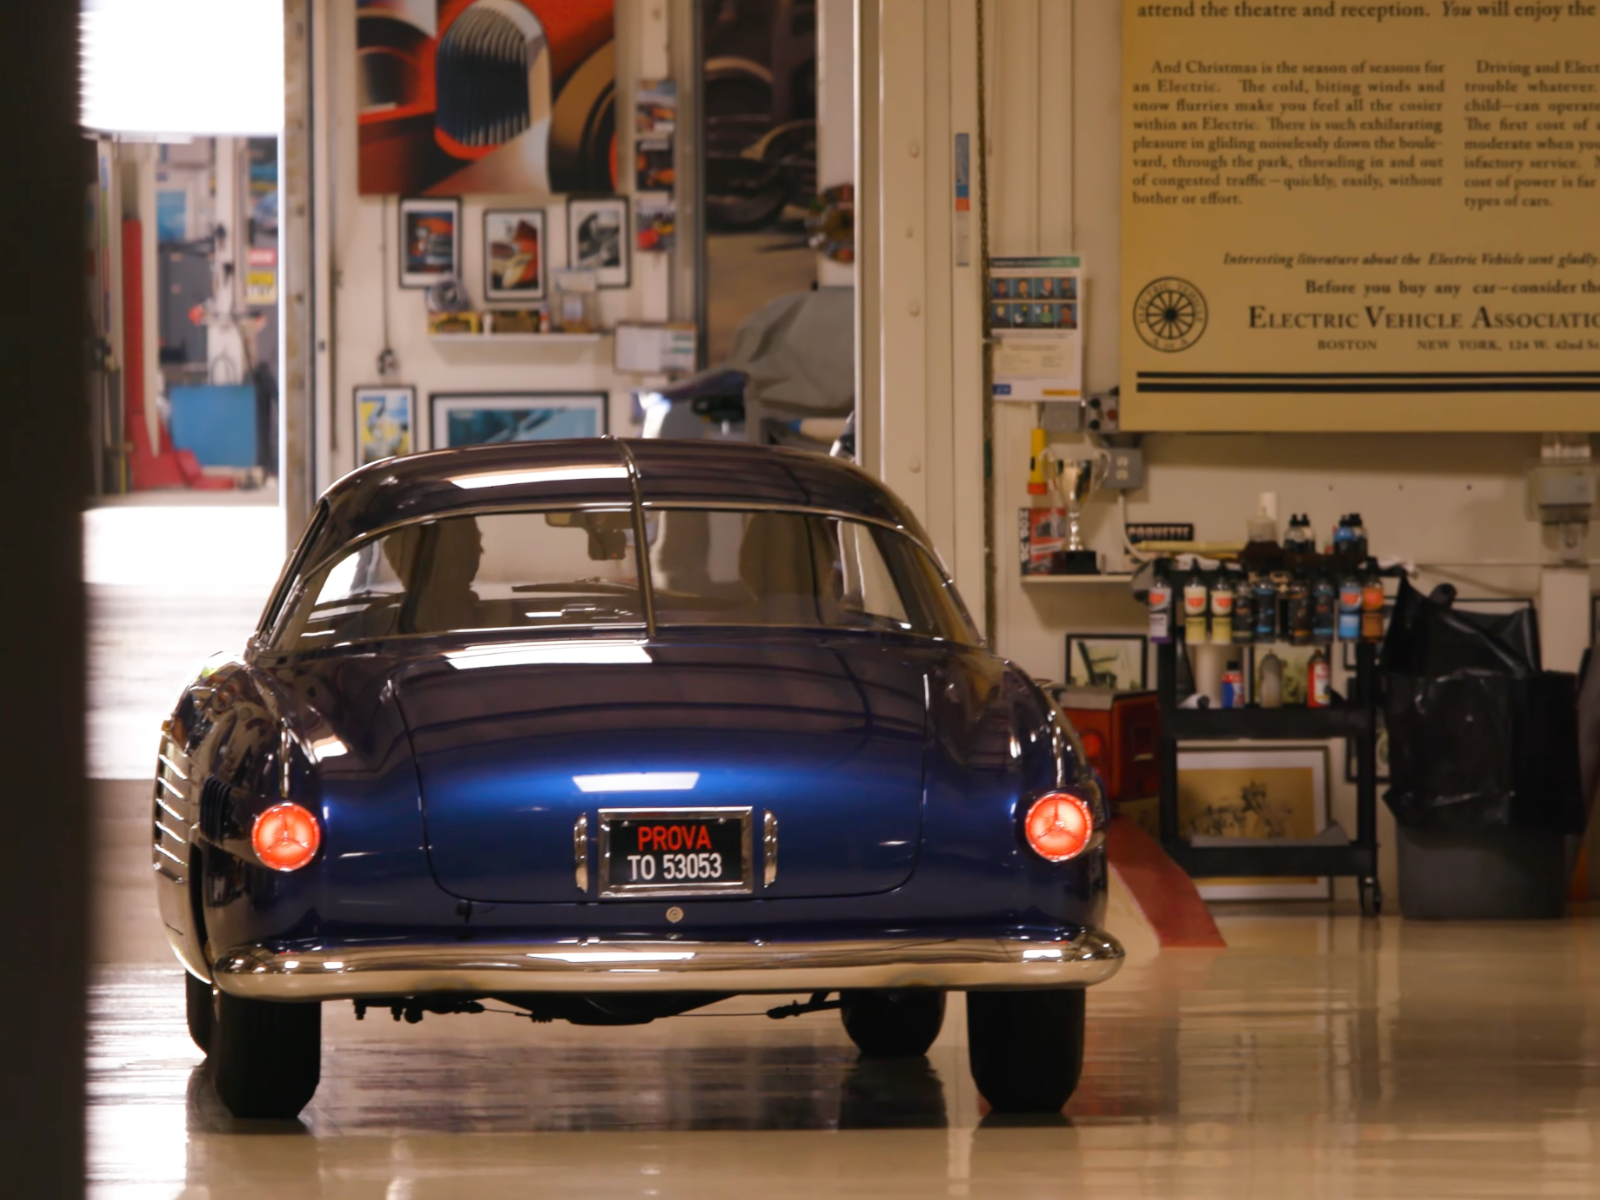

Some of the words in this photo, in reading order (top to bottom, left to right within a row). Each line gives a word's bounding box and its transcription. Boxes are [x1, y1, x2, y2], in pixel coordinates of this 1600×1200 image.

[1136, 0, 1196, 17] attend
[1199, 0, 1230, 17] the
[1233, 0, 1298, 17] theatre
[1301, 0, 1337, 17] and
[1340, 2, 1431, 22] reception.
[1441, 0, 1473, 17] You
[1475, 0, 1511, 17] will
[1513, 1, 1564, 22] enjoy
[1567, 0, 1597, 16] the
[1152, 60, 1181, 74] And
[1186, 60, 1257, 74] Christmas
[1261, 62, 1273, 74] is
[1277, 60, 1297, 74] the
[1302, 64, 1347, 74] season
[1350, 60, 1367, 74] of
[1369, 64, 1420, 74] seasons
[1425, 60, 1444, 73] for
[1476, 59, 1531, 77] Driving
[1534, 60, 1561, 74] and
[1131, 83, 1151, 92] an
[1157, 79, 1221, 93] Electric.
[1239, 78, 1266, 93] The
[1272, 79, 1309, 94] cold,
[1316, 79, 1362, 97] biting
[1368, 79, 1411, 93] winds
[1418, 79, 1445, 93] and
[1465, 79, 1518, 93] trouble
[1527, 79, 1598, 93] whatever.
[1133, 102, 1170, 111] snow
[1176, 98, 1229, 112] flurries
[1235, 98, 1274, 112] make
[1279, 103, 1307, 115] you
[1313, 98, 1340, 112] feel
[1345, 97, 1365, 112] all
[1370, 98, 1393, 111] the
[1399, 100, 1443, 111] cosier
[1133, 117, 1177, 130] within
[1180, 121, 1199, 131] an
[1202, 116, 1260, 130] Electric.
[1267, 116, 1306, 131] There
[1309, 119, 1322, 130] is
[1325, 117, 1357, 130] such
[1360, 117, 1443, 134] exhilarating
[1464, 116, 1491, 131] The
[1499, 117, 1528, 131] first
[1536, 120, 1565, 131] cost
[1572, 117, 1591, 131] of
[1133, 136, 1187, 153] pleasure
[1190, 137, 1206, 149] in
[1208, 136, 1256, 153] gliding
[1259, 136, 1330, 153] noiselessly
[1333, 136, 1371, 149] down
[1374, 136, 1395, 149] the
[1465, 136, 1532, 150] moderate
[1536, 137, 1574, 150] when
[1133, 154, 1167, 169] vard,
[1173, 155, 1228, 172] through
[1232, 155, 1254, 168] the
[1257, 155, 1293, 172] park,
[1299, 154, 1365, 172] threading
[1370, 156, 1385, 168] in
[1390, 154, 1415, 168] and
[1420, 158, 1443, 168] out
[1464, 155, 1524, 172] isfactory
[1529, 157, 1582, 169] service.
[1131, 173, 1149, 186] of
[1152, 171, 1221, 190] congested
[1342, 171, 1384, 190] easily,
[1388, 173, 1443, 187] without
[1465, 178, 1492, 188] cost
[1495, 174, 1512, 188] of
[1514, 179, 1556, 192] power
[1562, 176, 1574, 188] is
[1577, 174, 1596, 188] far
[1133, 191, 1178, 204] bother
[1181, 195, 1197, 204] or
[1200, 191, 1242, 205] effort.
[1465, 197, 1500, 211] types
[1503, 191, 1520, 207] of
[1522, 198, 1552, 207] cars.
[1224, 252, 1294, 269] Interesting
[1297, 253, 1359, 265] literature
[1362, 253, 1398, 265] about
[1401, 253, 1421, 265] the
[1429, 252, 1477, 265] Electric
[1482, 253, 1524, 265] Vehicle
[1528, 255, 1554, 265] sent
[1306, 279, 1356, 294] Before
[1364, 284, 1392, 298] you
[1399, 280, 1427, 297] buy
[1434, 284, 1461, 298] any
[1248, 305, 1359, 329] ELECTRIC
[1364, 305, 1463, 329] VEHICLE
[1318, 339, 1377, 350] BOSTON
[1418, 340, 1449, 350] NEW
[1459, 339, 1501, 351] YORK,
[637, 825, 712, 851] PROVA
[627, 854, 656, 880] TO
[663, 853, 722, 879] 53053
